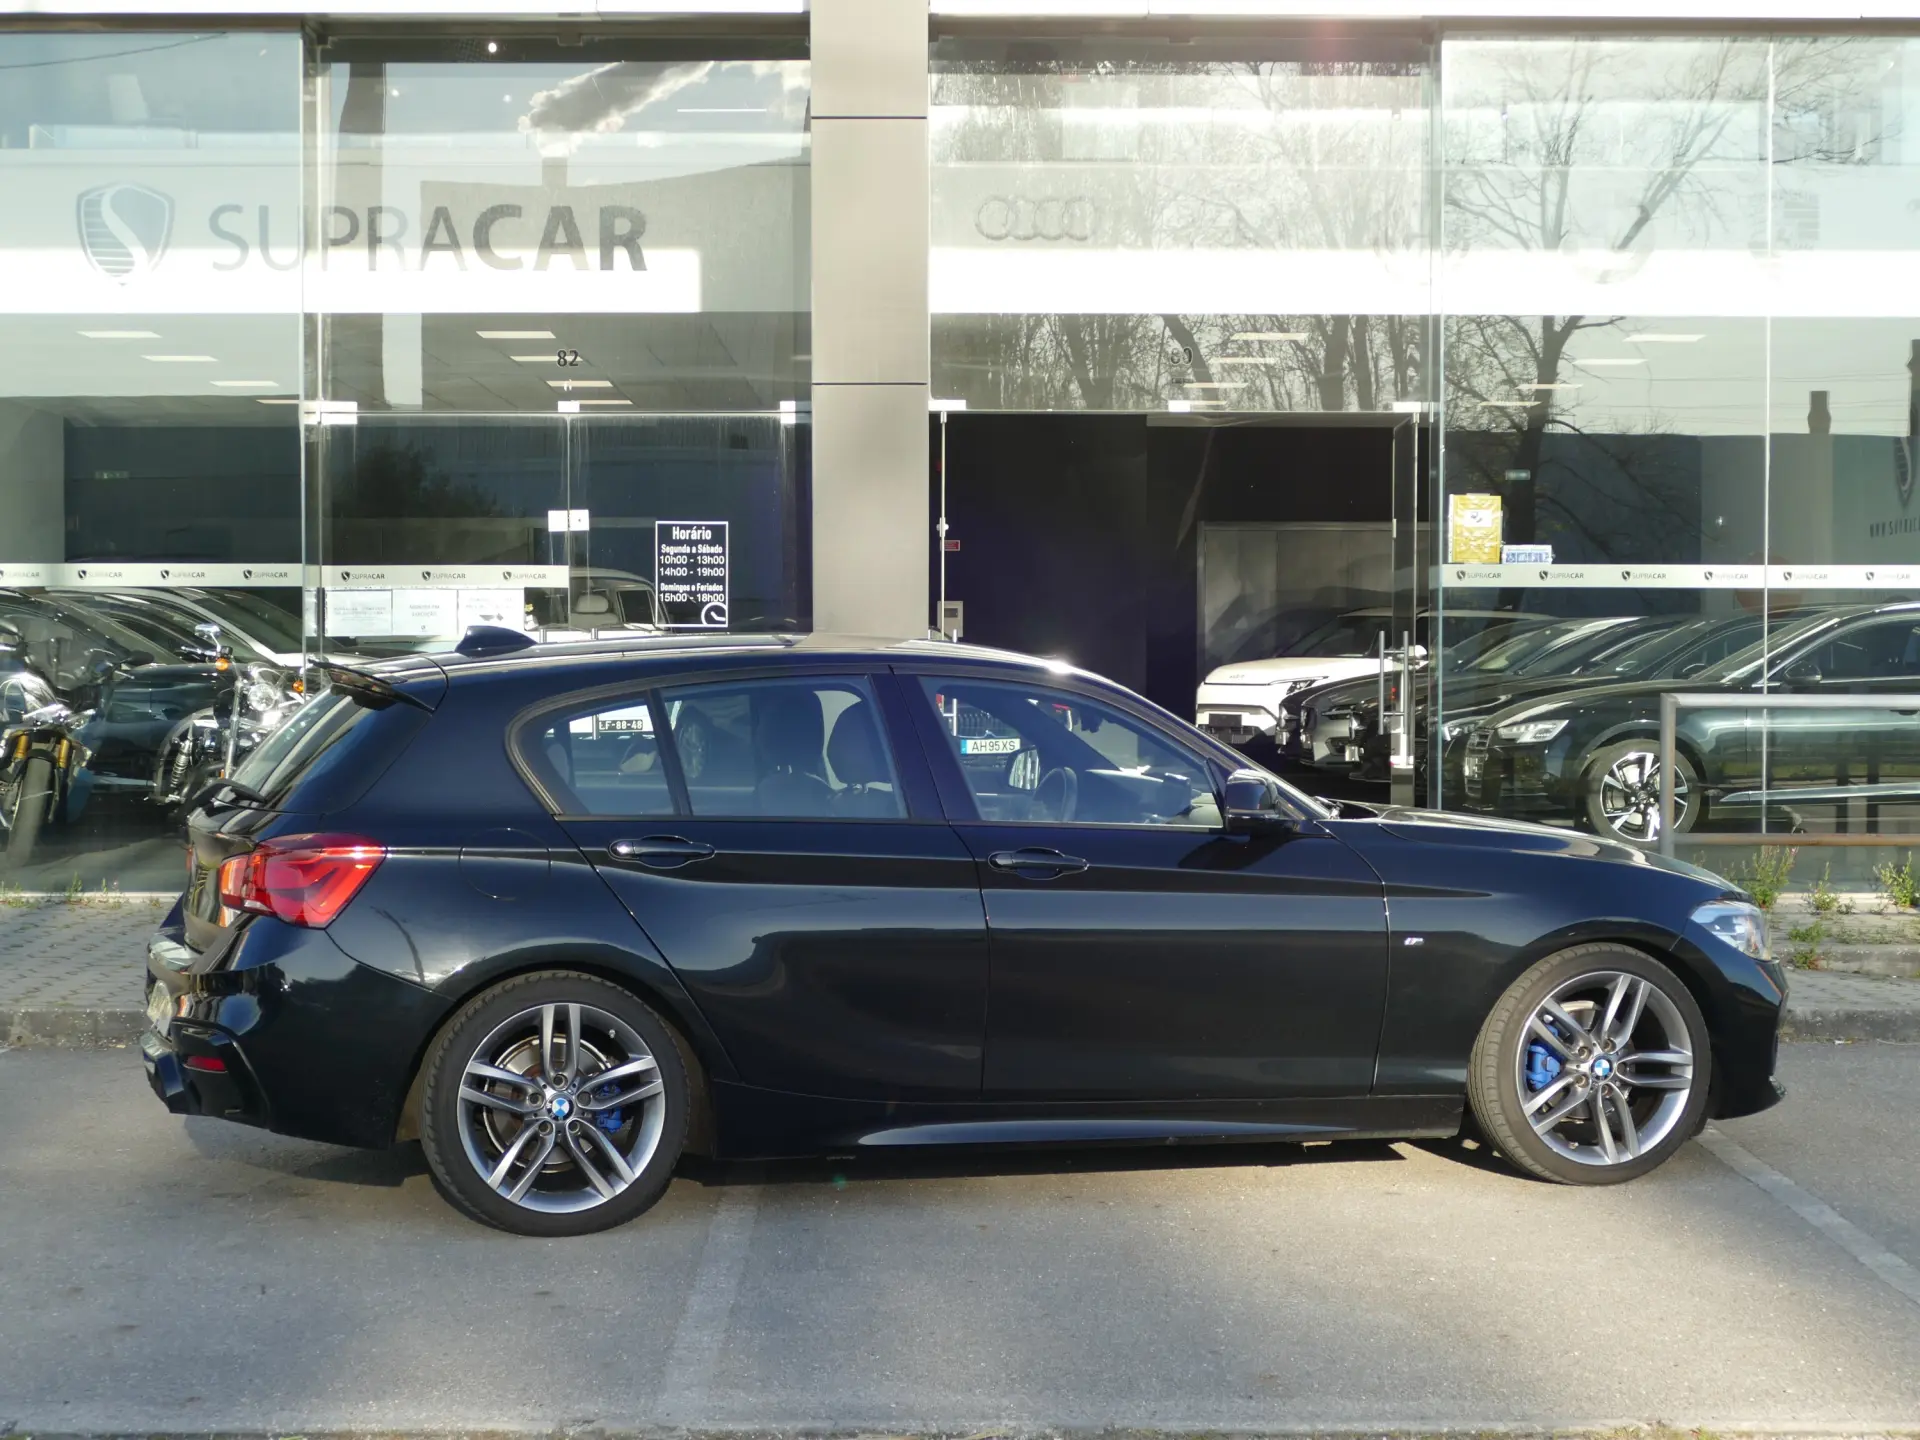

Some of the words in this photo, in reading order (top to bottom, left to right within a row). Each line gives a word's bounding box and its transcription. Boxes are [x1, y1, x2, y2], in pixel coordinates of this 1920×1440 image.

[208, 203, 648, 271] SUPRACAR
[557, 349, 579, 367] 82
[672, 526, 712, 540] Horário
[661, 544, 690, 555] Segunda
[698, 544, 723, 553] Sábado
[660, 555, 688, 564] 10h00
[697, 555, 725, 564] 13h00
[660, 567, 688, 576] 14h00
[697, 567, 725, 576] 19h00
[660, 583, 690, 593] Domingos
[697, 583, 724, 592] Feriados
[660, 593, 688, 602] 15h00
[697, 593, 725, 602] 18h00
